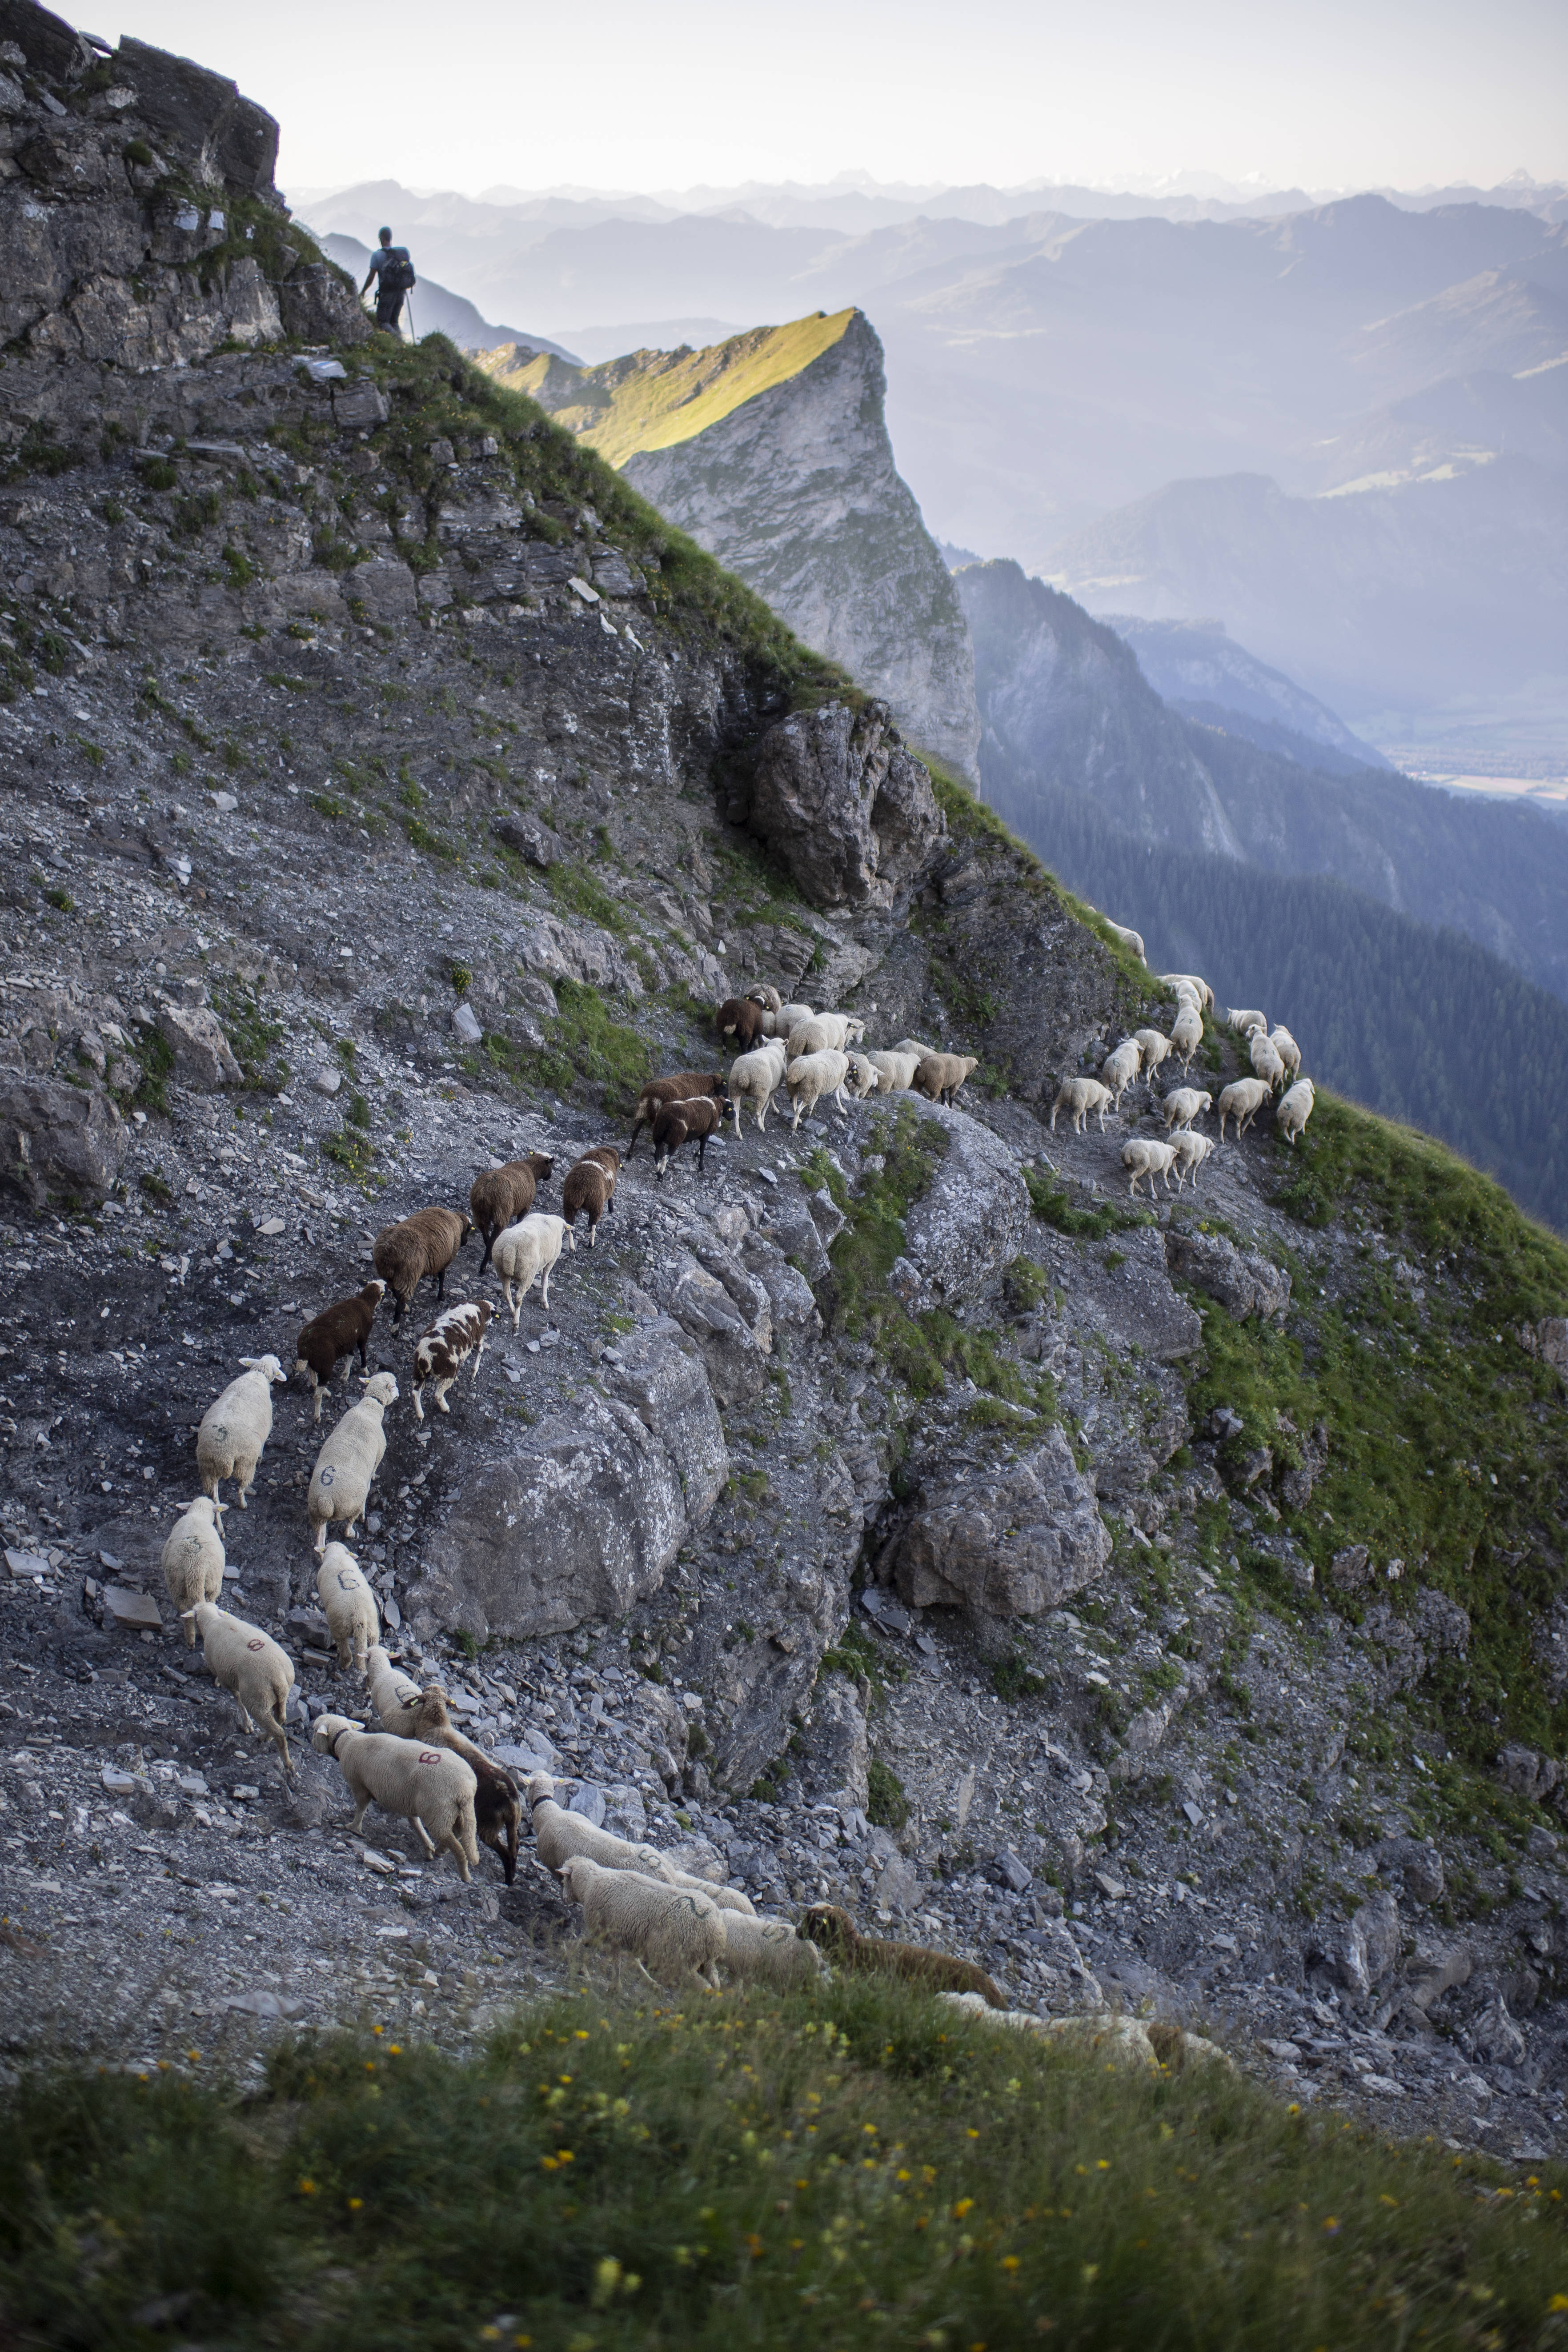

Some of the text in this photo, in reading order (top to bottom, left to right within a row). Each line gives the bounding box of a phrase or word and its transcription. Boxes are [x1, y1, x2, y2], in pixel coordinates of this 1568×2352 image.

[1113, 1057, 1120, 1067] 6
[321, 1465, 336, 1487] 6
[337, 1569, 360, 1591] 6
[419, 1751, 441, 1765] 6
